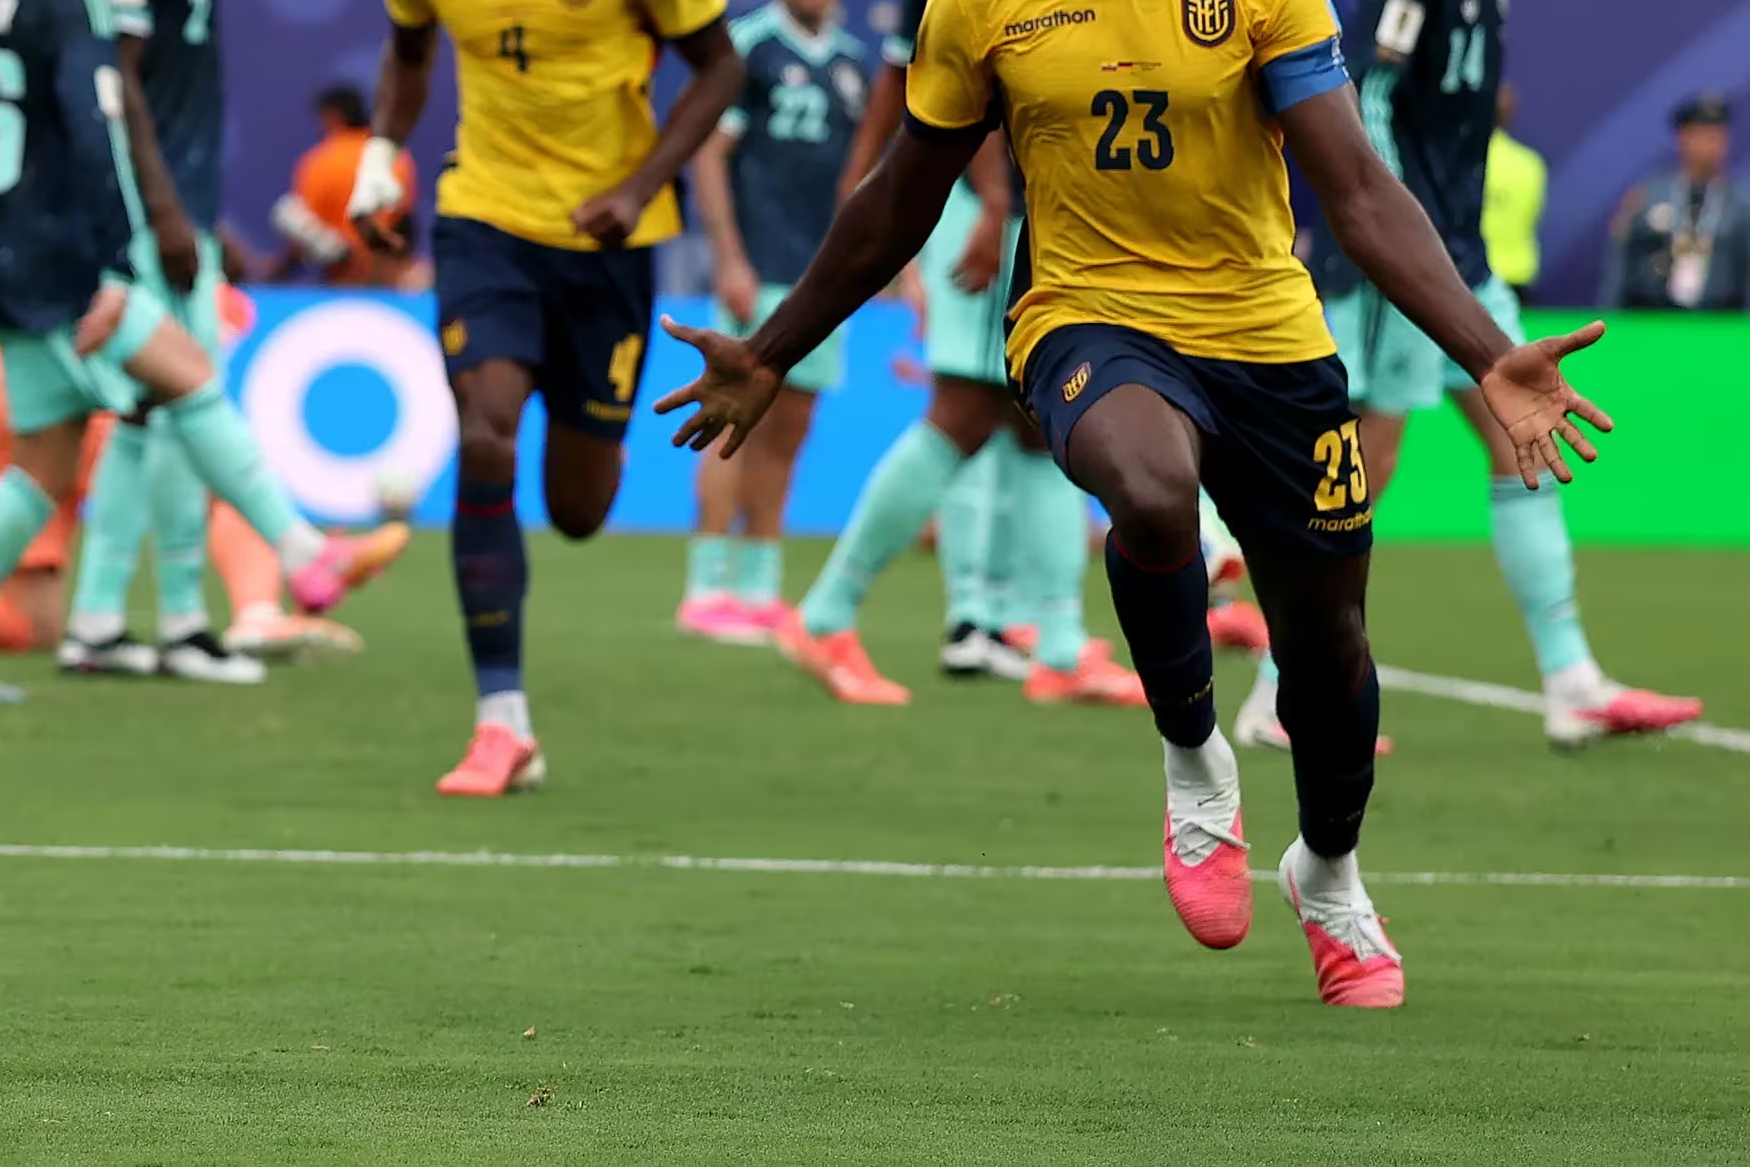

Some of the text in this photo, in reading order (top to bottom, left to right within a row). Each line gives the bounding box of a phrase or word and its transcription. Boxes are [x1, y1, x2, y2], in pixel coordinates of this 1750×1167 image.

[498, 23, 529, 74] 4
[1004, 8, 1096, 36] marathon
[1439, 24, 1486, 94] 14
[1091, 89, 1174, 170] 23
[608, 334, 643, 402] 4
[1313, 418, 1368, 511] 23
[1307, 506, 1371, 531] maratho
